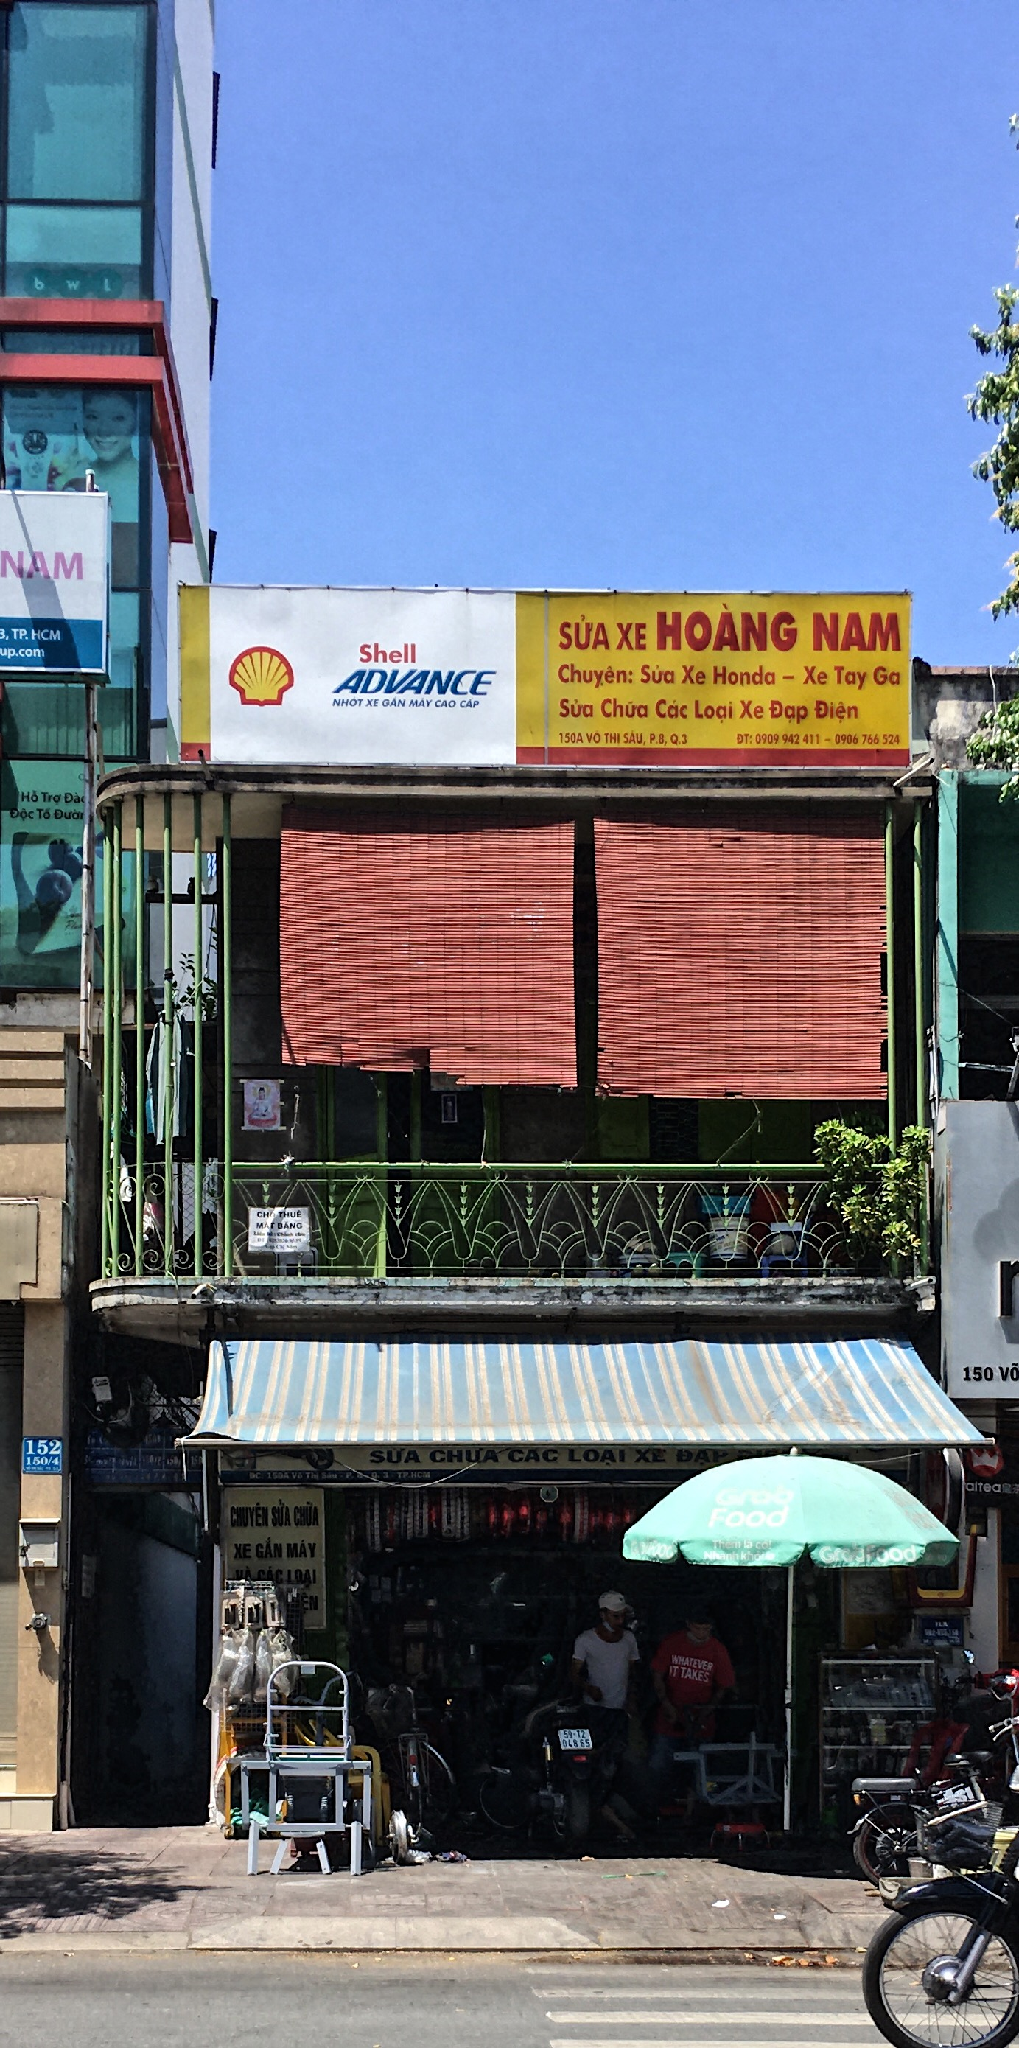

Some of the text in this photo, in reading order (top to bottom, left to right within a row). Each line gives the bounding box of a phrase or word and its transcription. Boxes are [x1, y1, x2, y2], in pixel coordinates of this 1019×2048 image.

[0, 550, 84, 580] NAM
[12, 628, 28, 640] TP.
[32, 629, 61, 640] HCM
[558, 603, 902, 652] SỬA XE HOÀNG NAM
[359, 643, 416, 663] Shell
[332, 668, 497, 696] ADVANCE
[557, 663, 633, 689] Chuyên:
[640, 664, 675, 684] Sửa
[681, 665, 706, 685] Xe
[712, 665, 776, 685] Honda
[802, 665, 828, 685] Xe
[833, 665, 867, 690] Tay
[873, 666, 901, 686] Ga
[364, 699, 380, 708] XE
[408, 697, 433, 708] MÁY
[434, 699, 457, 708] CAO
[558, 698, 859, 725] Sửa Chữa Các Loại Xe Đạp Điện
[558, 732, 584, 745] 150A
[670, 732, 688, 746] Q.3
[755, 733, 779, 745] 0909
[781, 733, 800, 745] 942
[802, 733, 820, 745] 411
[835, 733, 859, 745] 0906
[862, 733, 880, 745] 766
[882, 733, 901, 745] 524
[962, 1366, 994, 1382] 150
[26, 1439, 61, 1455] 152
[634, 1448, 667, 1463] XE
[26, 1456, 60, 1466] 150/4
[714, 1484, 795, 1507] Grab
[708, 1505, 790, 1528] Food
[233, 1543, 252, 1559] XE
[286, 1539, 317, 1558] MÁY
[671, 1654, 714, 1671] WHATEVER
[670, 1665, 710, 1683] IT TAKES
